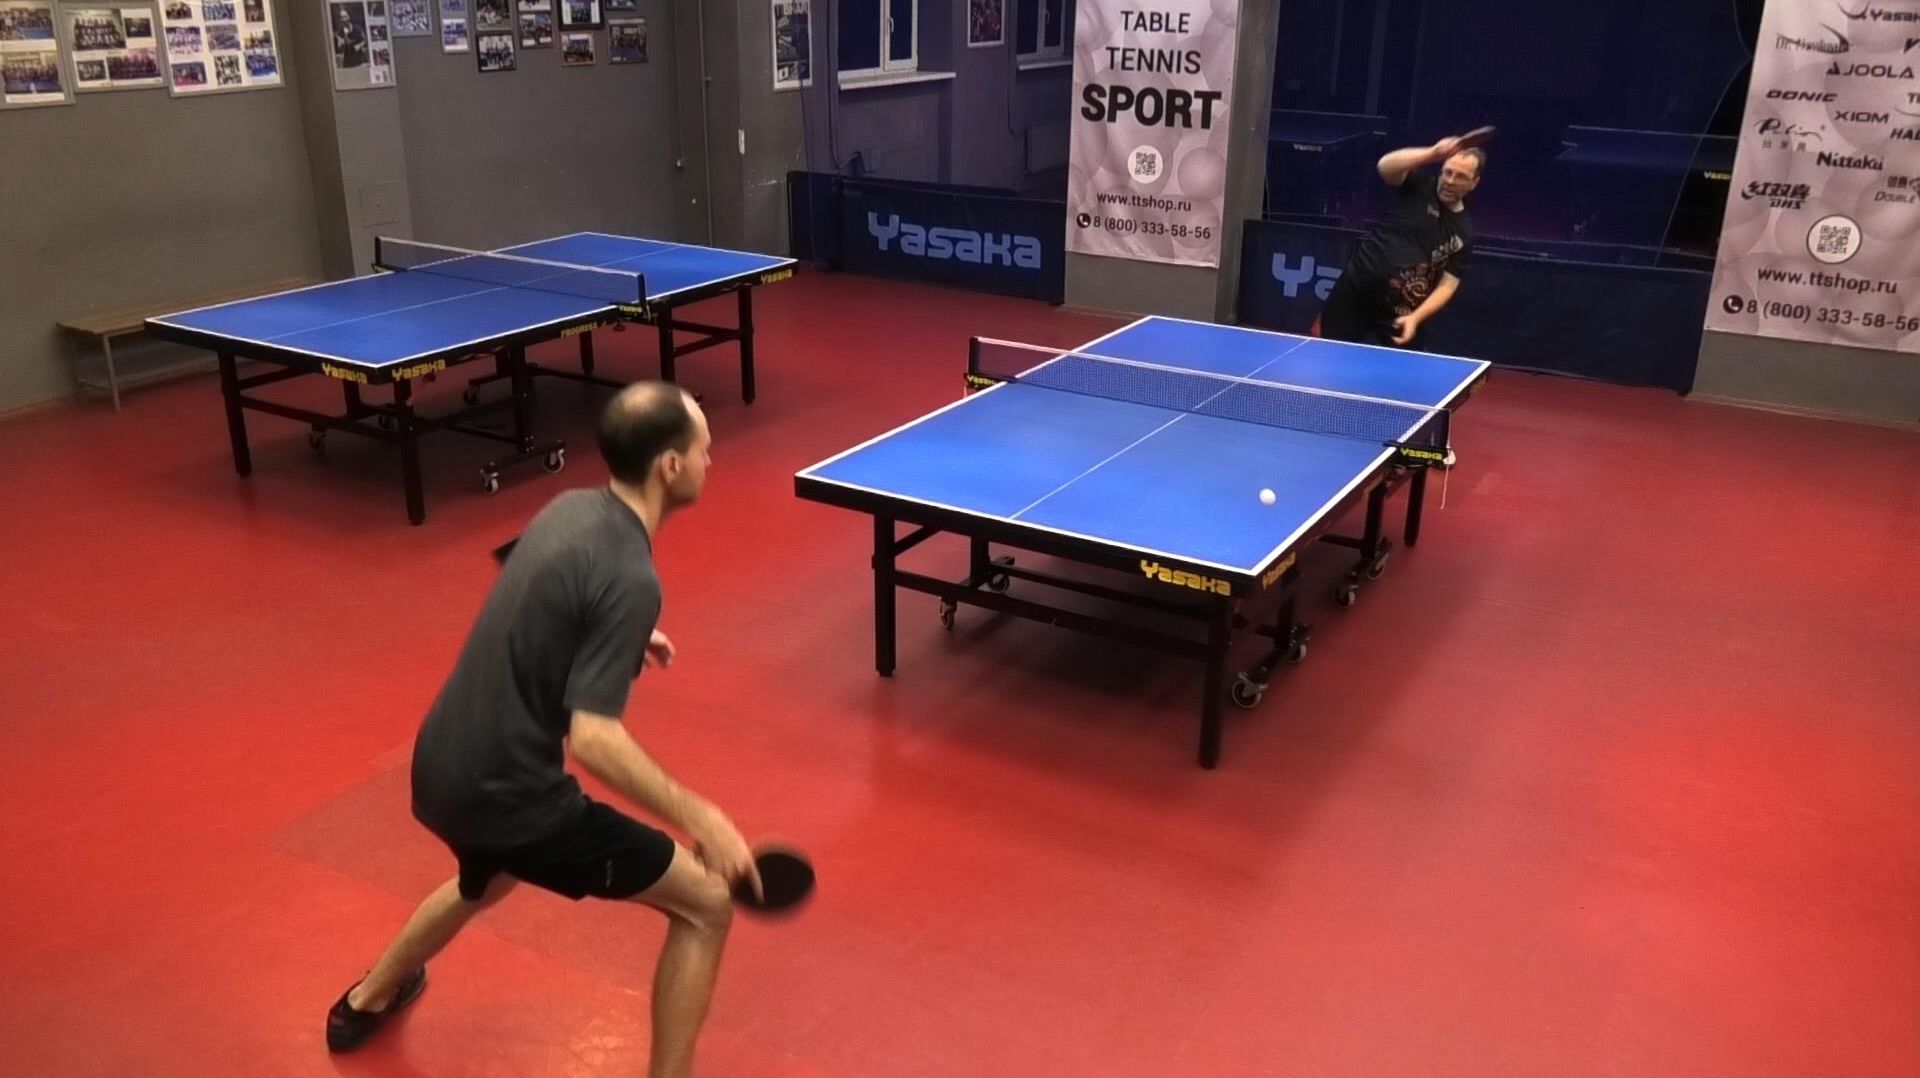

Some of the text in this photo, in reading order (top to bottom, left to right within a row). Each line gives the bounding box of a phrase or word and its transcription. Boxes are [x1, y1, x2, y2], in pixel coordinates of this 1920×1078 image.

[1120, 10, 1191, 33] TABLE
[1106, 46, 1201, 75] TENNIS
[1843, 63, 1915, 79] JOOLA
[1081, 83, 1222, 130] SPORT
[1766, 89, 1838, 103] DONIC
[1834, 110, 1889, 124] XIOM
[1817, 151, 1884, 171] Nittaku
[1096, 192, 1192, 212] www.ttshop.ru
[1093, 216, 1211, 239] 8 (800) 333-58-56
[867, 211, 1041, 269] Yasaka
[1758, 267, 1898, 294] www.ttshop.ru
[1747, 300, 1919, 332] 8 (800) 333-58-56
[392, 359, 446, 382] Yasaka
[1400, 447, 1443, 460] Yasaka
[1140, 559, 1232, 597] Yasaka
